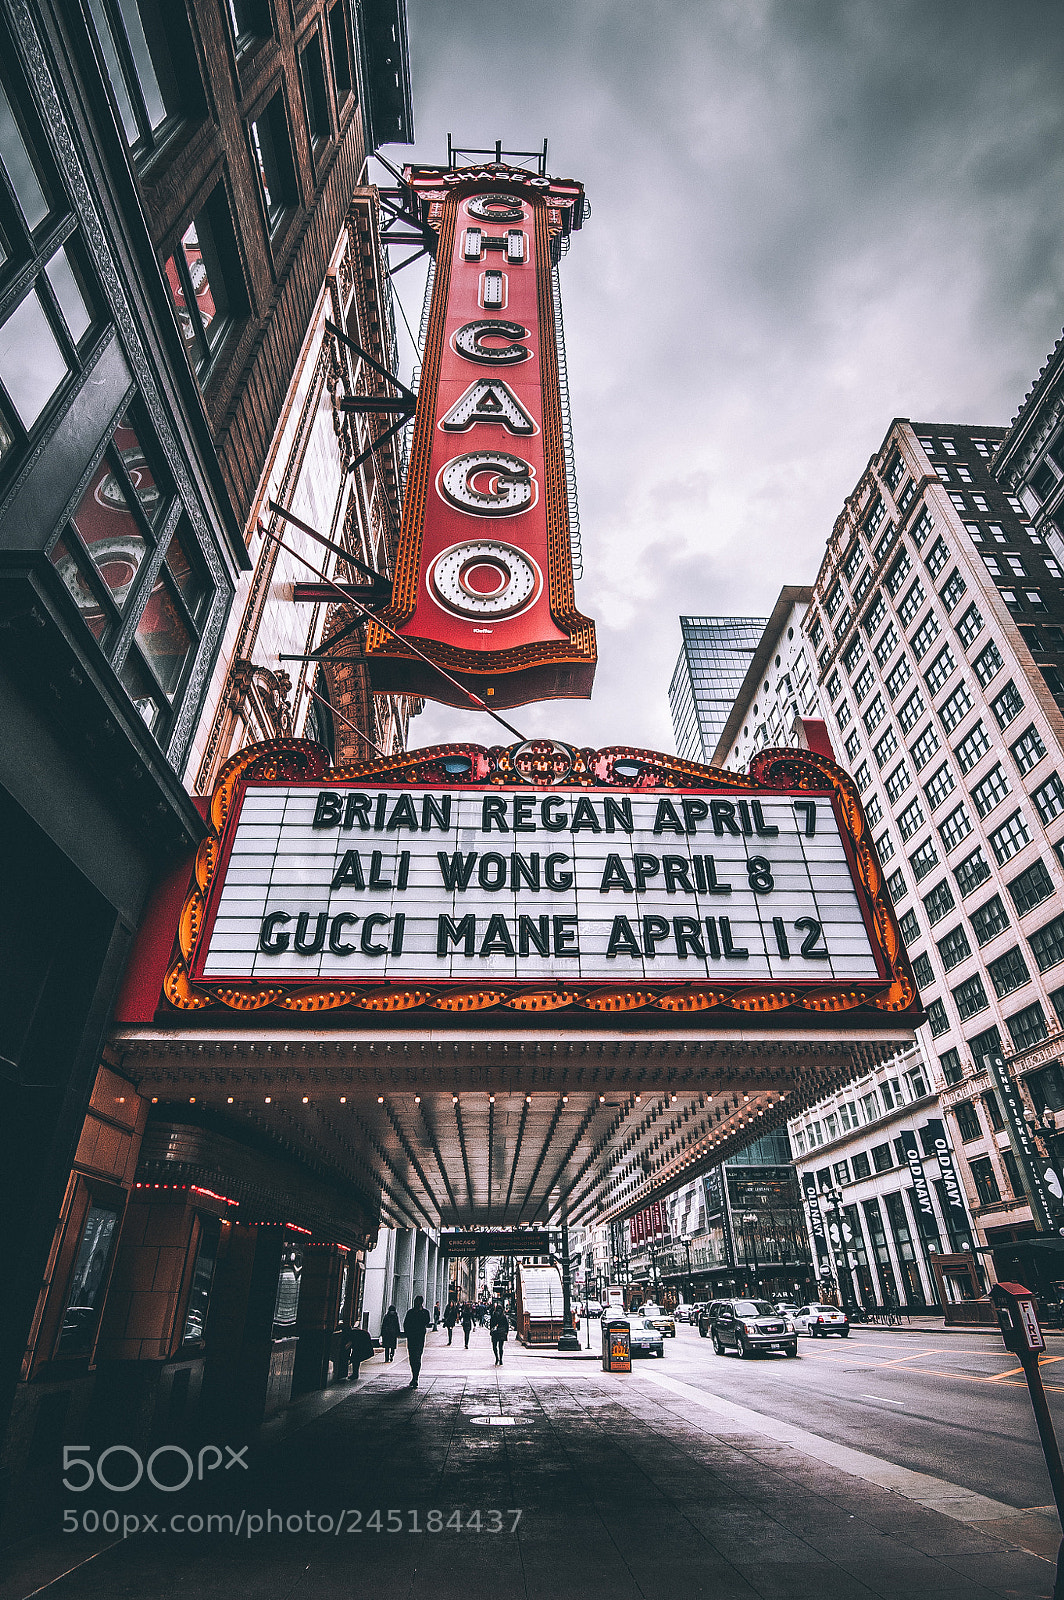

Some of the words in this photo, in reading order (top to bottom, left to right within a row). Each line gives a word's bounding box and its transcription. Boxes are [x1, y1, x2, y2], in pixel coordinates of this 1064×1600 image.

[443, 172, 527, 182] CHASE
[425, 192, 544, 623] CHICAGO
[312, 791, 451, 832] BRIAN
[482, 795, 634, 834] REGAN
[653, 797, 779, 836] APRIL
[794, 800, 816, 838] 7
[330, 850, 410, 891] ALI
[437, 851, 573, 893] WONG
[600, 853, 732, 894] APRIL
[747, 855, 775, 894] 8
[260, 910, 406, 957] GUCCI
[437, 914, 579, 958] MANE
[606, 915, 748, 960] APRIL
[772, 916, 829, 960] 12
[995, 1058, 1011, 1093] GENE
[1008, 1099, 1032, 1155] SISKEL
[934, 1138, 951, 1168] OLD
[1029, 1162, 1041, 1185] FILM
[806, 1187, 817, 1209] OLD
[906, 1149, 922, 1177] OLD
[914, 1177, 933, 1215] NAVY
[942, 1168, 963, 1208] NAVY
[810, 1209, 824, 1238] NAVY
[1020, 1302, 1040, 1346] FIRE
